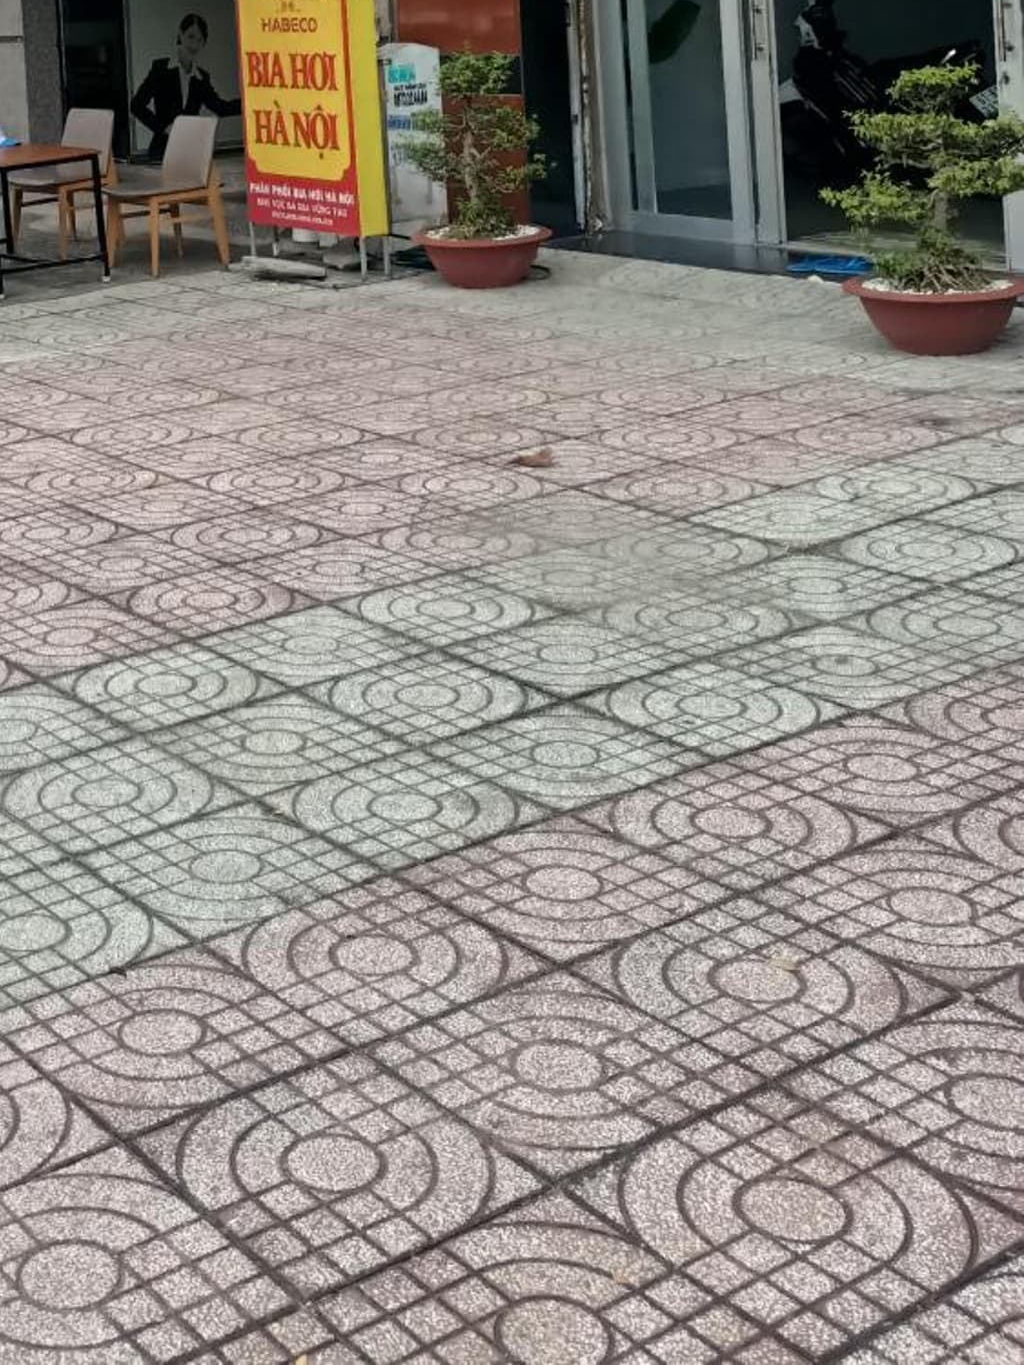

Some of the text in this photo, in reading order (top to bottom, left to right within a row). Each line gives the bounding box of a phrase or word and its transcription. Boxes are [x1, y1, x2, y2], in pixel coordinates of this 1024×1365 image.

[261, 17, 318, 34] HABECO
[246, 51, 339, 92] BIA HƠI
[252, 101, 341, 160] HÀ NỘI
